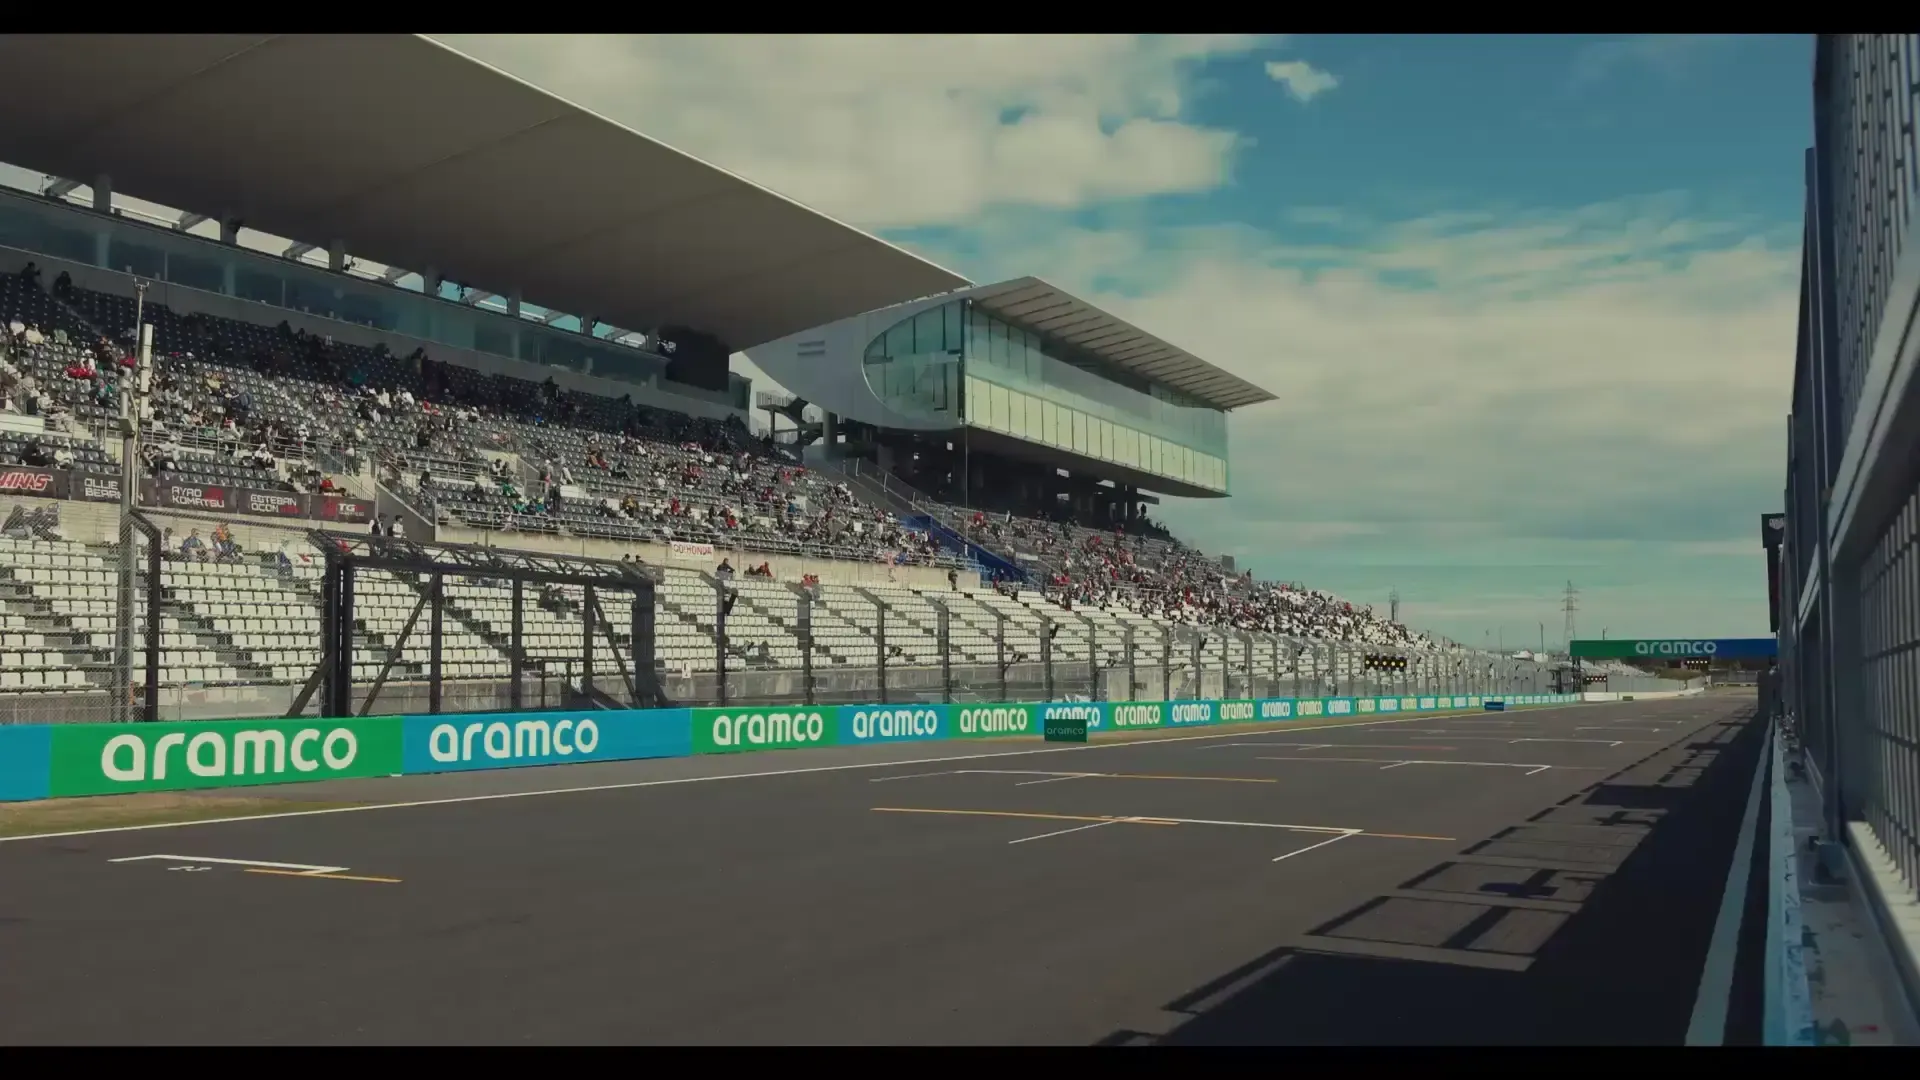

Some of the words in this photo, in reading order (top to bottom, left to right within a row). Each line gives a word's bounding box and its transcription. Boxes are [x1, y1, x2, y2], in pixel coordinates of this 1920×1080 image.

[84, 478, 119, 490] OLLIE
[171, 485, 202, 498] AYAO
[84, 487, 144, 501] BEARN
[172, 495, 225, 508] KOMATSU
[250, 493, 297, 506] ESTEBAN
[251, 502, 279, 513] OCON
[1635, 641, 1717, 654] aramco
[1115, 705, 1160, 726] aramco
[1172, 704, 1210, 722] aramco
[1220, 703, 1253, 720] aramco
[1262, 702, 1290, 717] aramco
[853, 710, 937, 738] aramco
[960, 708, 1027, 733] aramco
[713, 713, 823, 746] aramco
[1047, 727, 1084, 735] aramco
[429, 719, 598, 762] aramco
[101, 728, 357, 782] aramco
